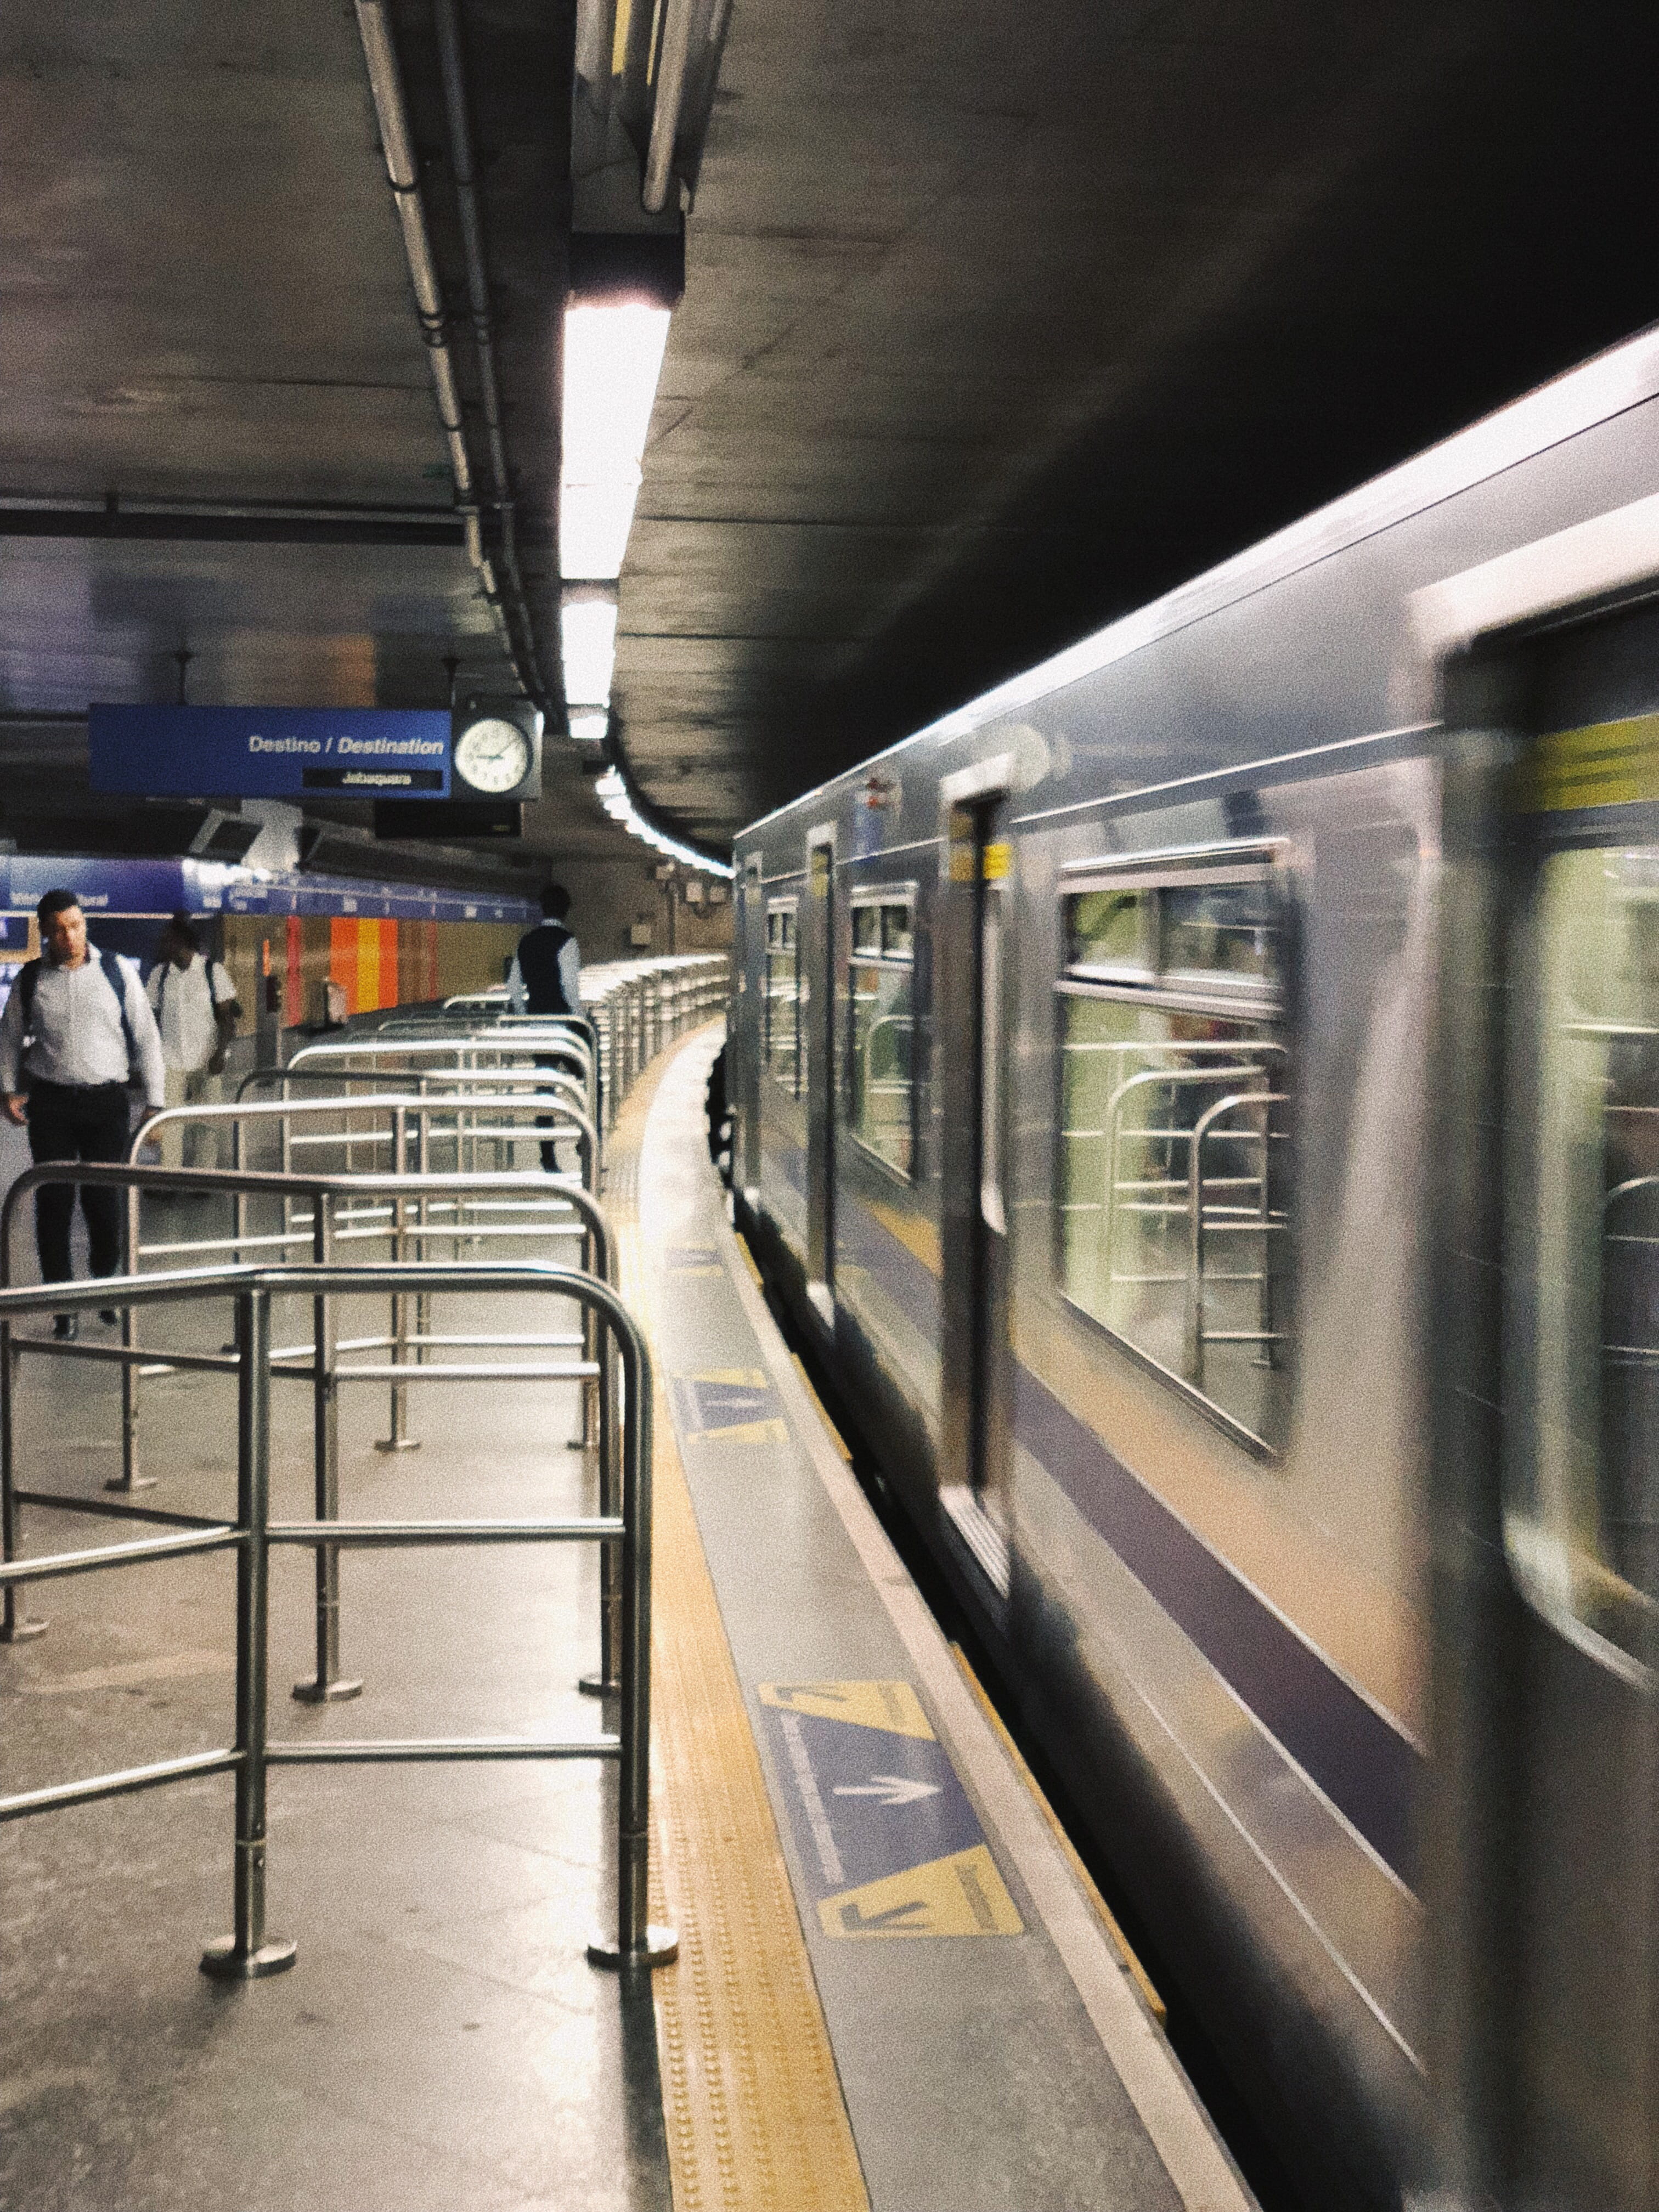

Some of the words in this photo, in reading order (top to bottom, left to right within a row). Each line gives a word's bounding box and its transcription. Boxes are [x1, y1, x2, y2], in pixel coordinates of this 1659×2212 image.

[249, 736, 321, 753] Destino
[325, 737, 333, 753] /
[337, 737, 444, 755] Destination
